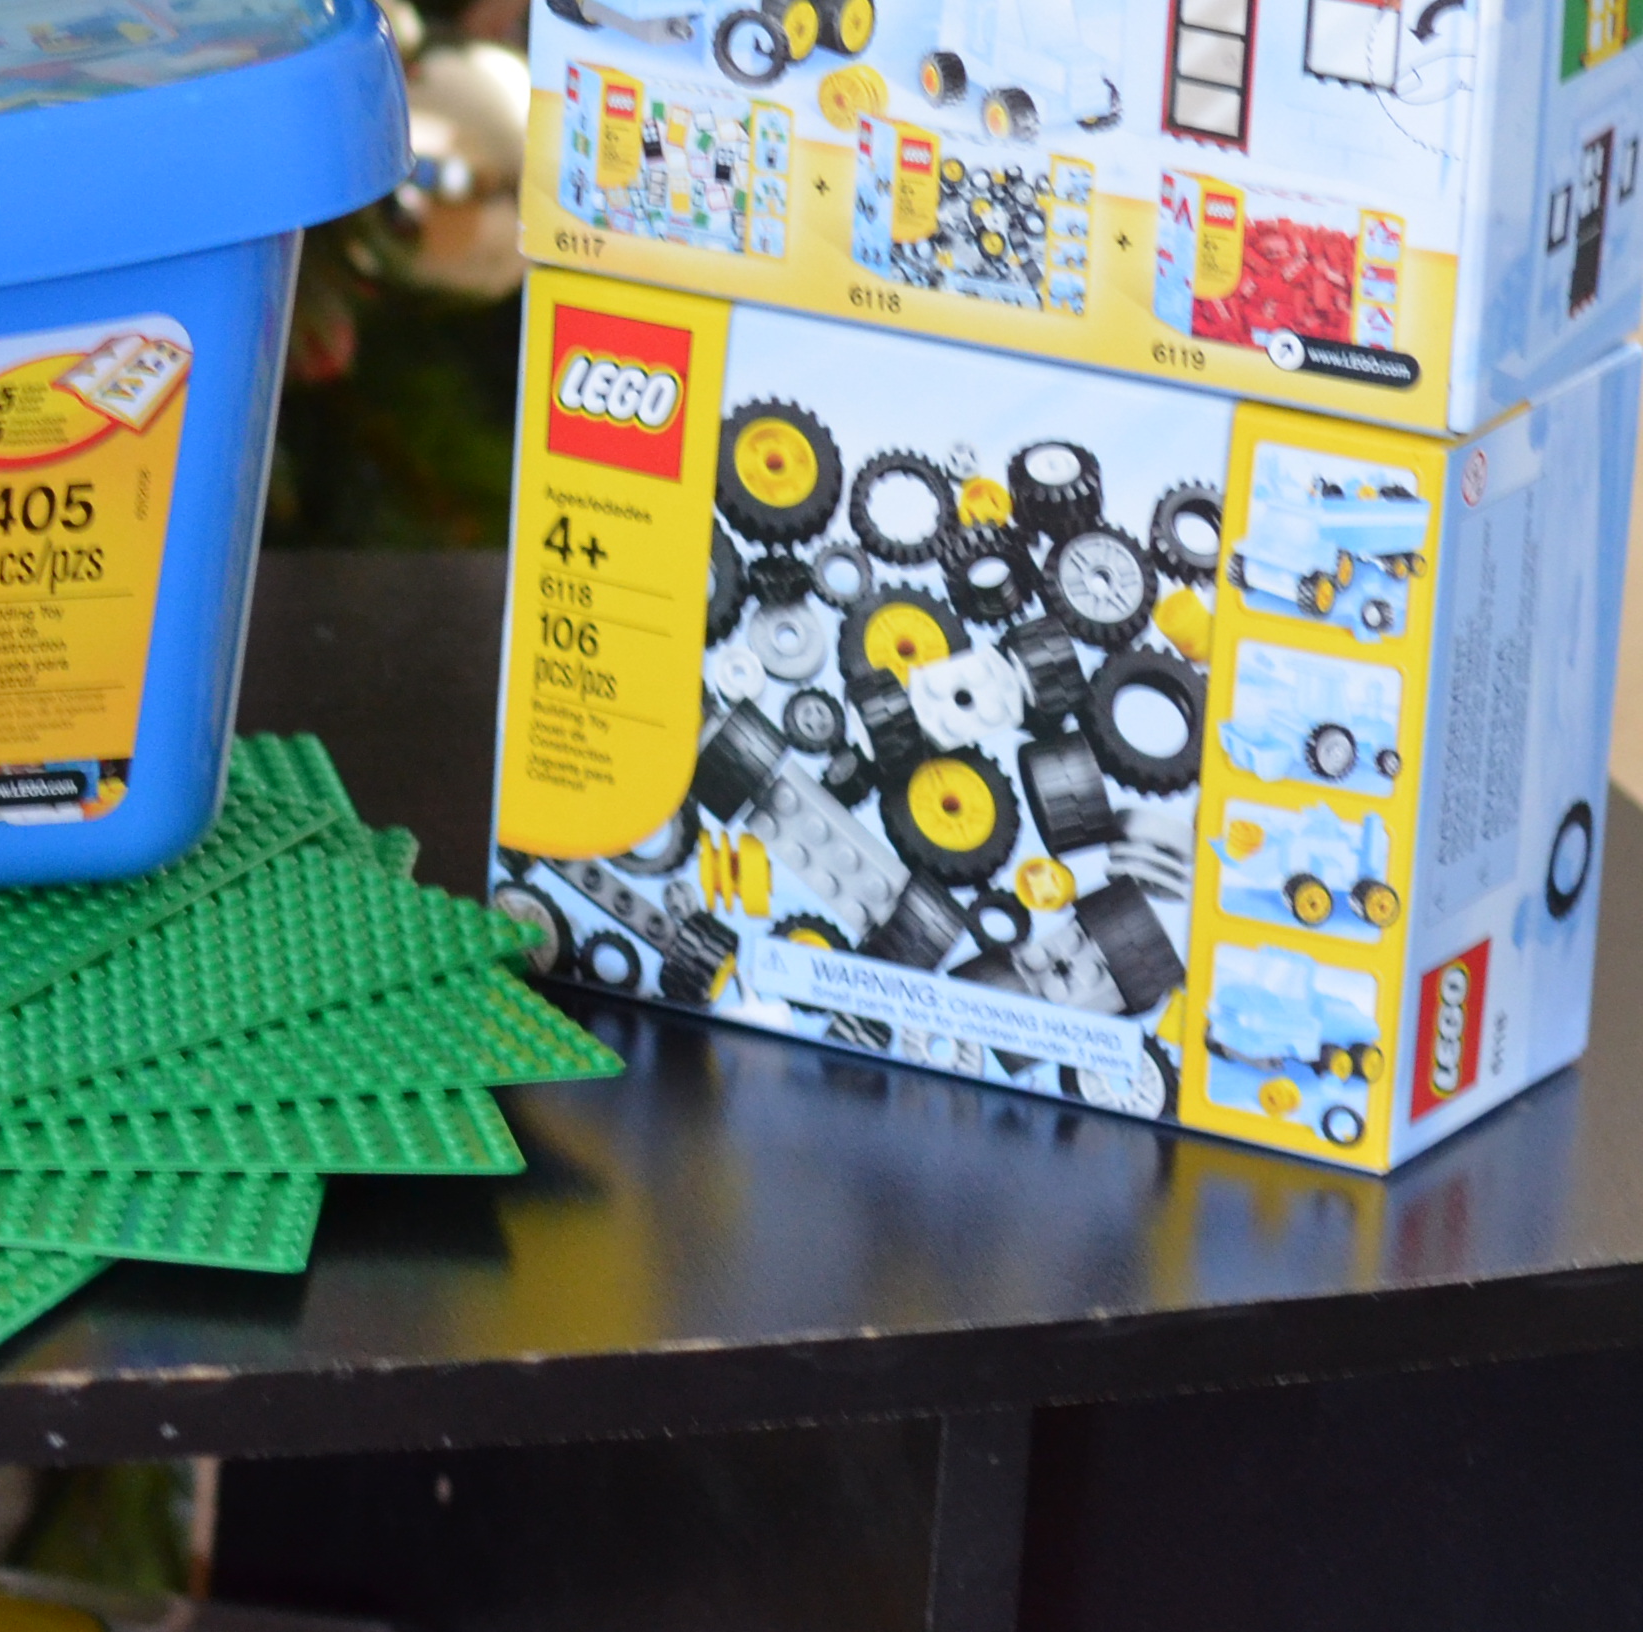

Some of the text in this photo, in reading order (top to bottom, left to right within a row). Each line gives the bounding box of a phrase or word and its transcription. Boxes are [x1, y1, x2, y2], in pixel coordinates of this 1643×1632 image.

[554, 232, 606, 258] 6117
[848, 287, 902, 314] 6118
[1152, 342, 1207, 371] 6119
[1307, 344, 1412, 380] www.LEGO.com
[557, 352, 680, 429] LEGO
[544, 483, 653, 526] Ages/edades
[542, 513, 608, 570] 4+
[40, 604, 65, 620] Toy
[539, 574, 594, 609] 6118
[540, 611, 600, 658] 106
[534, 653, 619, 703] pcs/pzs
[810, 954, 943, 1010] WARNING:
[946, 997, 1038, 1032] CHOKING
[1429, 964, 1469, 1096] LEGO
